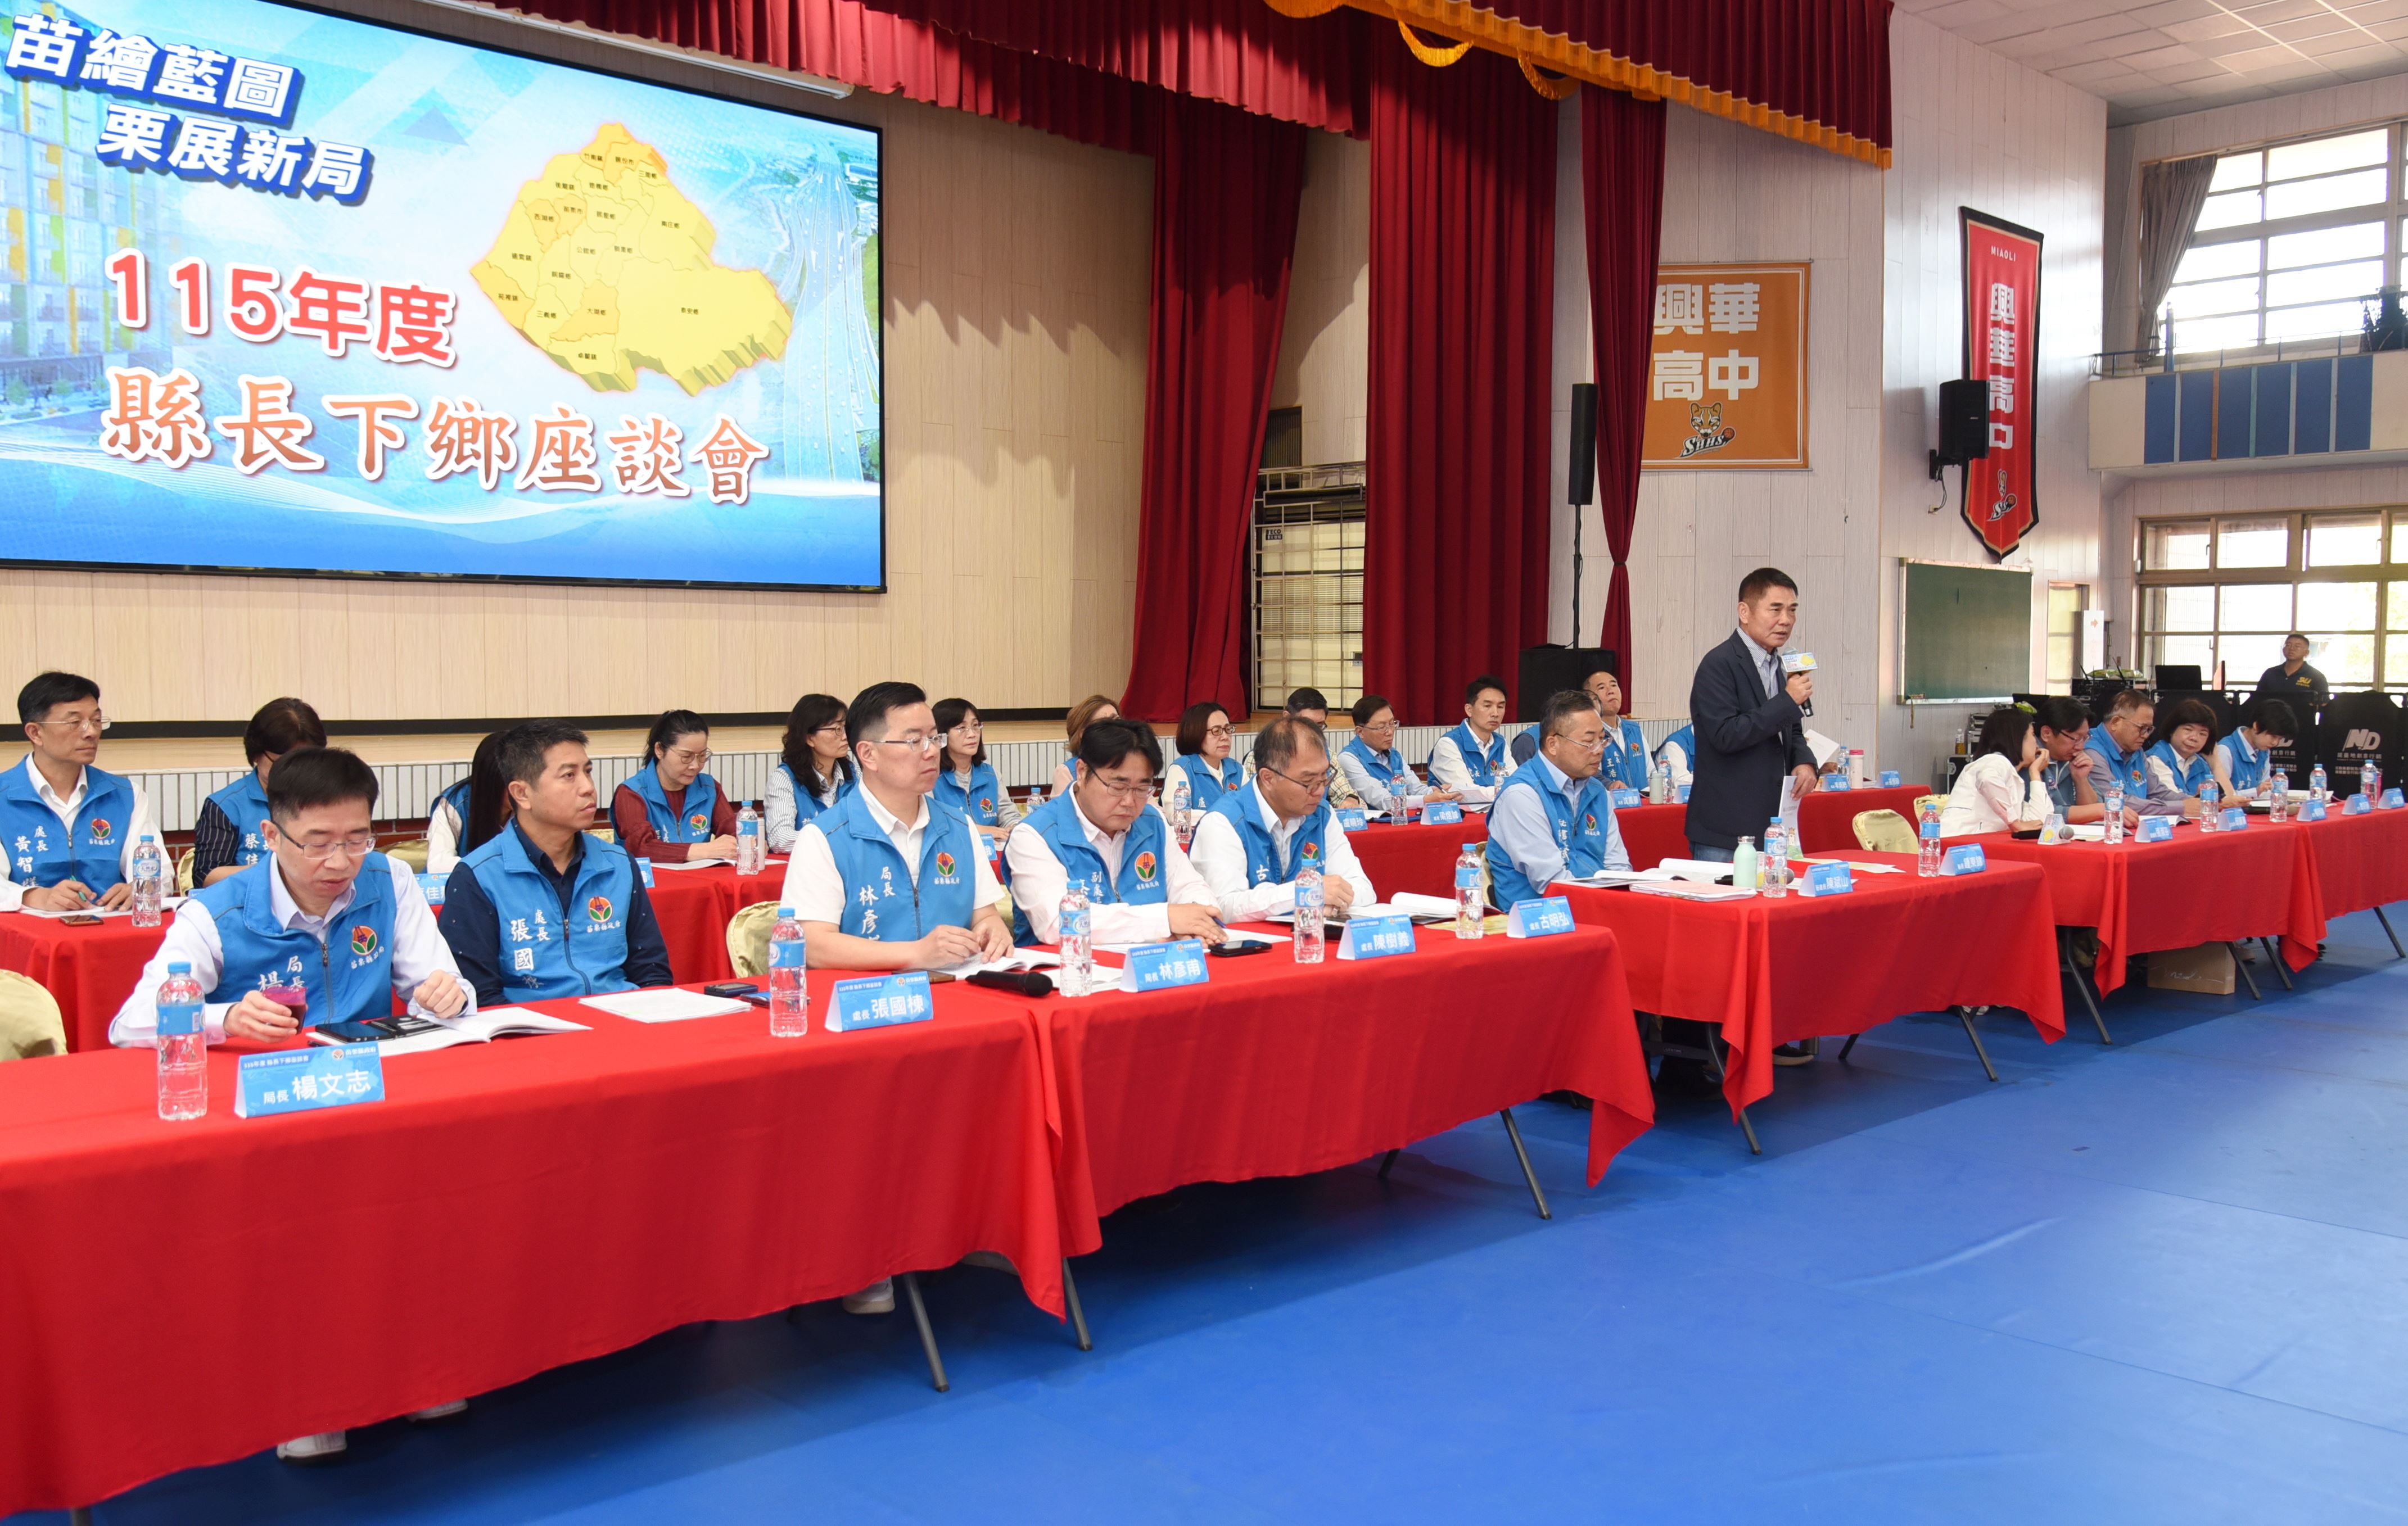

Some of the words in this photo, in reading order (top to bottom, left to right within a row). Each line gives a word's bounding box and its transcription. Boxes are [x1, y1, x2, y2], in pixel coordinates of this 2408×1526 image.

[6, 15, 295, 119] 苗繪藍圖
[97, 103, 365, 195] 栗展新局
[1991, 245, 2017, 262] MIAOLI
[110, 253, 451, 363] 115年度
[1654, 283, 1760, 334] 興華
[1653, 349, 1759, 401] 高中
[106, 372, 767, 500] 縣長下鄉座談會
[34, 825, 49, 852] 處長
[881, 866, 896, 897] 局長
[1256, 864, 1269, 881] 古
[535, 909, 550, 941] 處長
[287, 956, 305, 988] 局長
[1159, 958, 1201, 980] 林彥甫
[852, 1009, 871, 1021] 處長
[870, 994, 925, 1019] 張國棟
[263, 1090, 289, 1105] 局長
[291, 1070, 372, 1101] 楊文志
